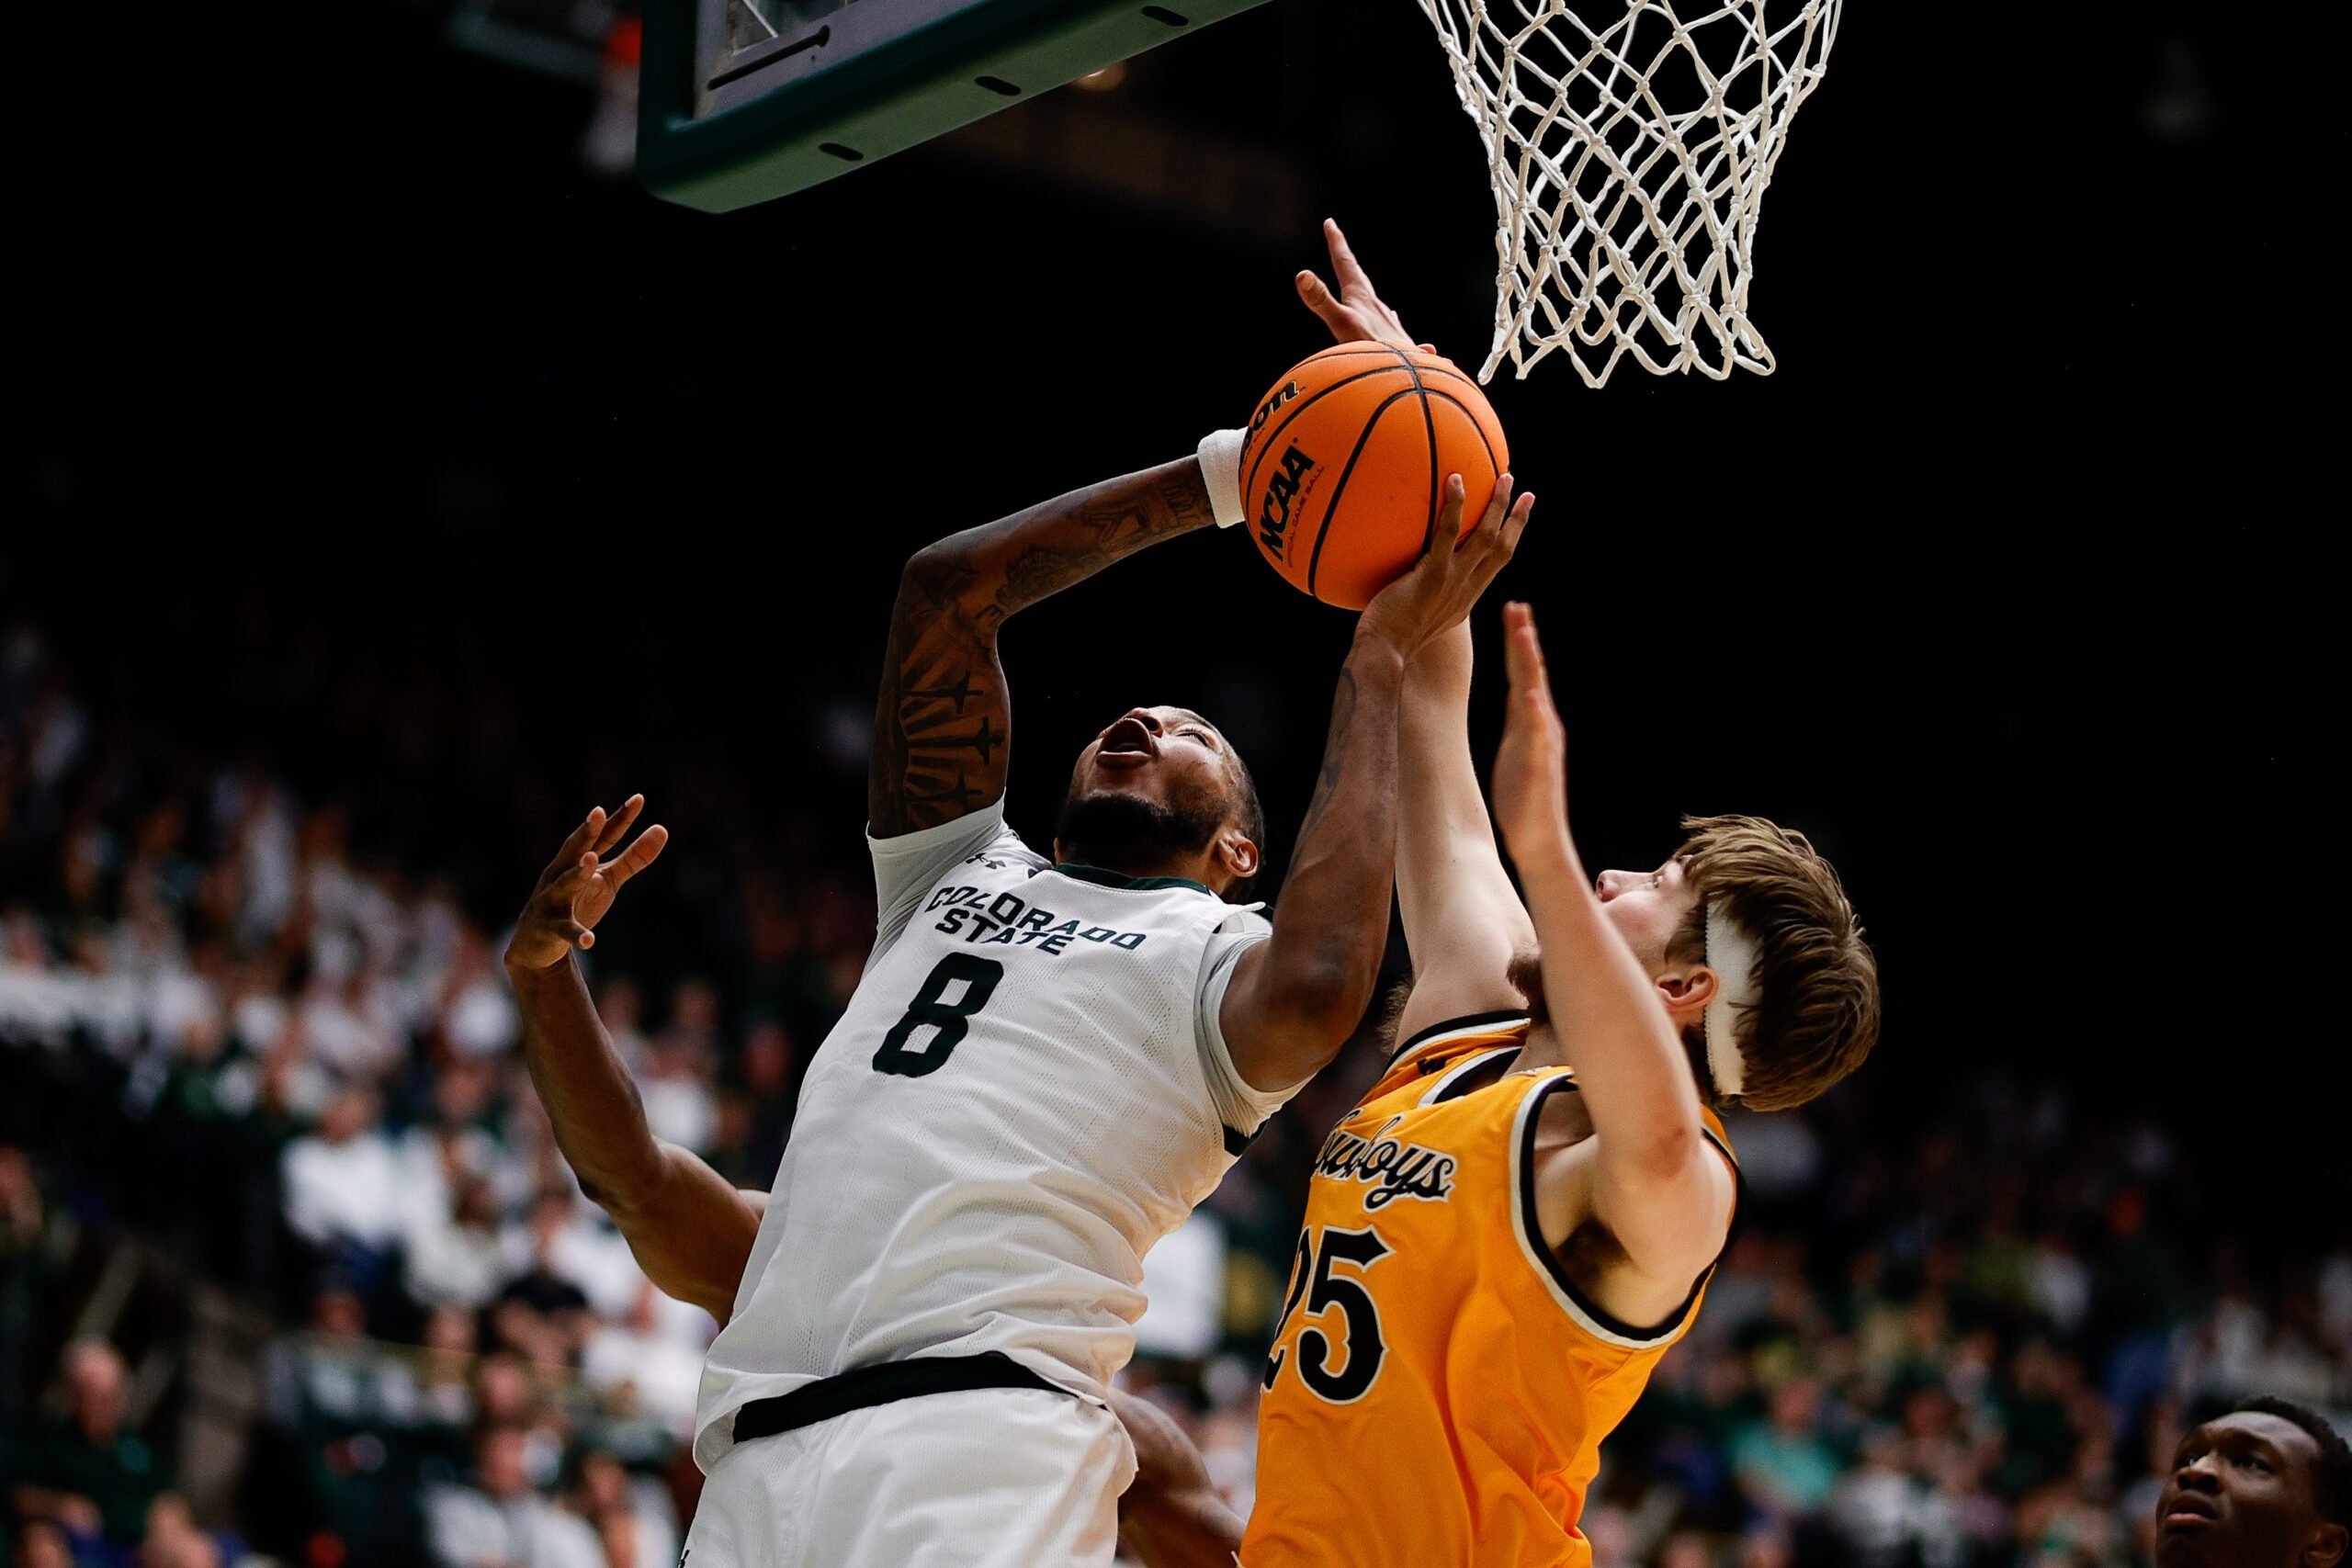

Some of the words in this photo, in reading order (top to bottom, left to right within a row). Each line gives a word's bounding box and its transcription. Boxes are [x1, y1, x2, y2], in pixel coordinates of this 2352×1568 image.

[1260, 445, 1316, 562] NCAA
[1305, 466, 1325, 494] BALL
[924, 886, 1147, 950] COLORADO
[934, 908, 1075, 955] STATE
[872, 952, 1004, 1078] 8
